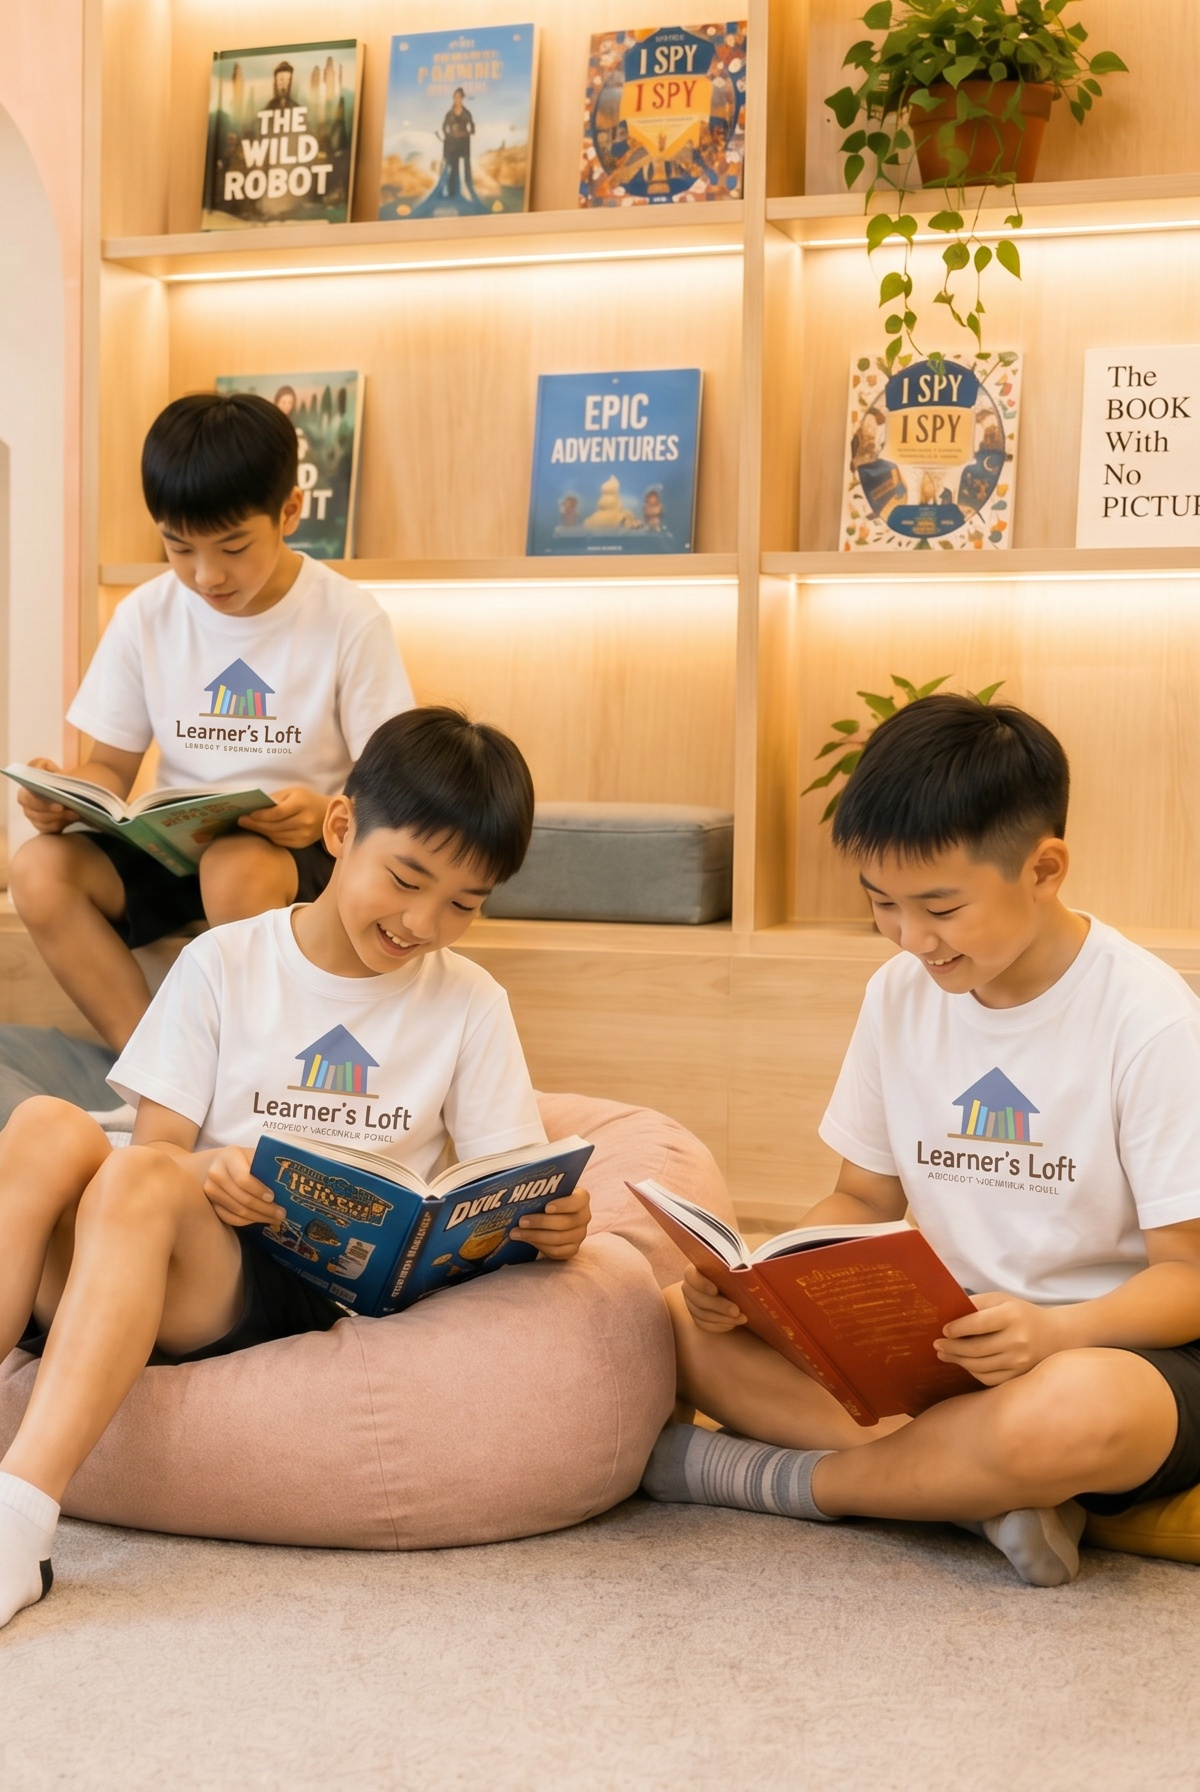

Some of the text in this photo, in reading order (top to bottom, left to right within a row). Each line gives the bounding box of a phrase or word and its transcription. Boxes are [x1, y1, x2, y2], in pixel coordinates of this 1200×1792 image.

[639, 44, 698, 75] I SPY
[635, 80, 697, 112] I SPY
[257, 106, 307, 135] THE
[241, 134, 319, 168] WILD
[224, 164, 333, 201] ROBOT
[901, 374, 963, 404] I SPY
[1107, 365, 1157, 387] The
[584, 393, 649, 431] EPIC
[1105, 397, 1192, 420] BOOK
[900, 414, 961, 444] I SPY
[1105, 430, 1169, 453] With
[551, 435, 679, 464] ADVENTURES
[1103, 464, 1141, 486] No
[176, 720, 301, 744] Learner's Loft
[253, 1092, 412, 1131] Learner's Loft
[917, 1140, 1077, 1182] Learner's Loft
